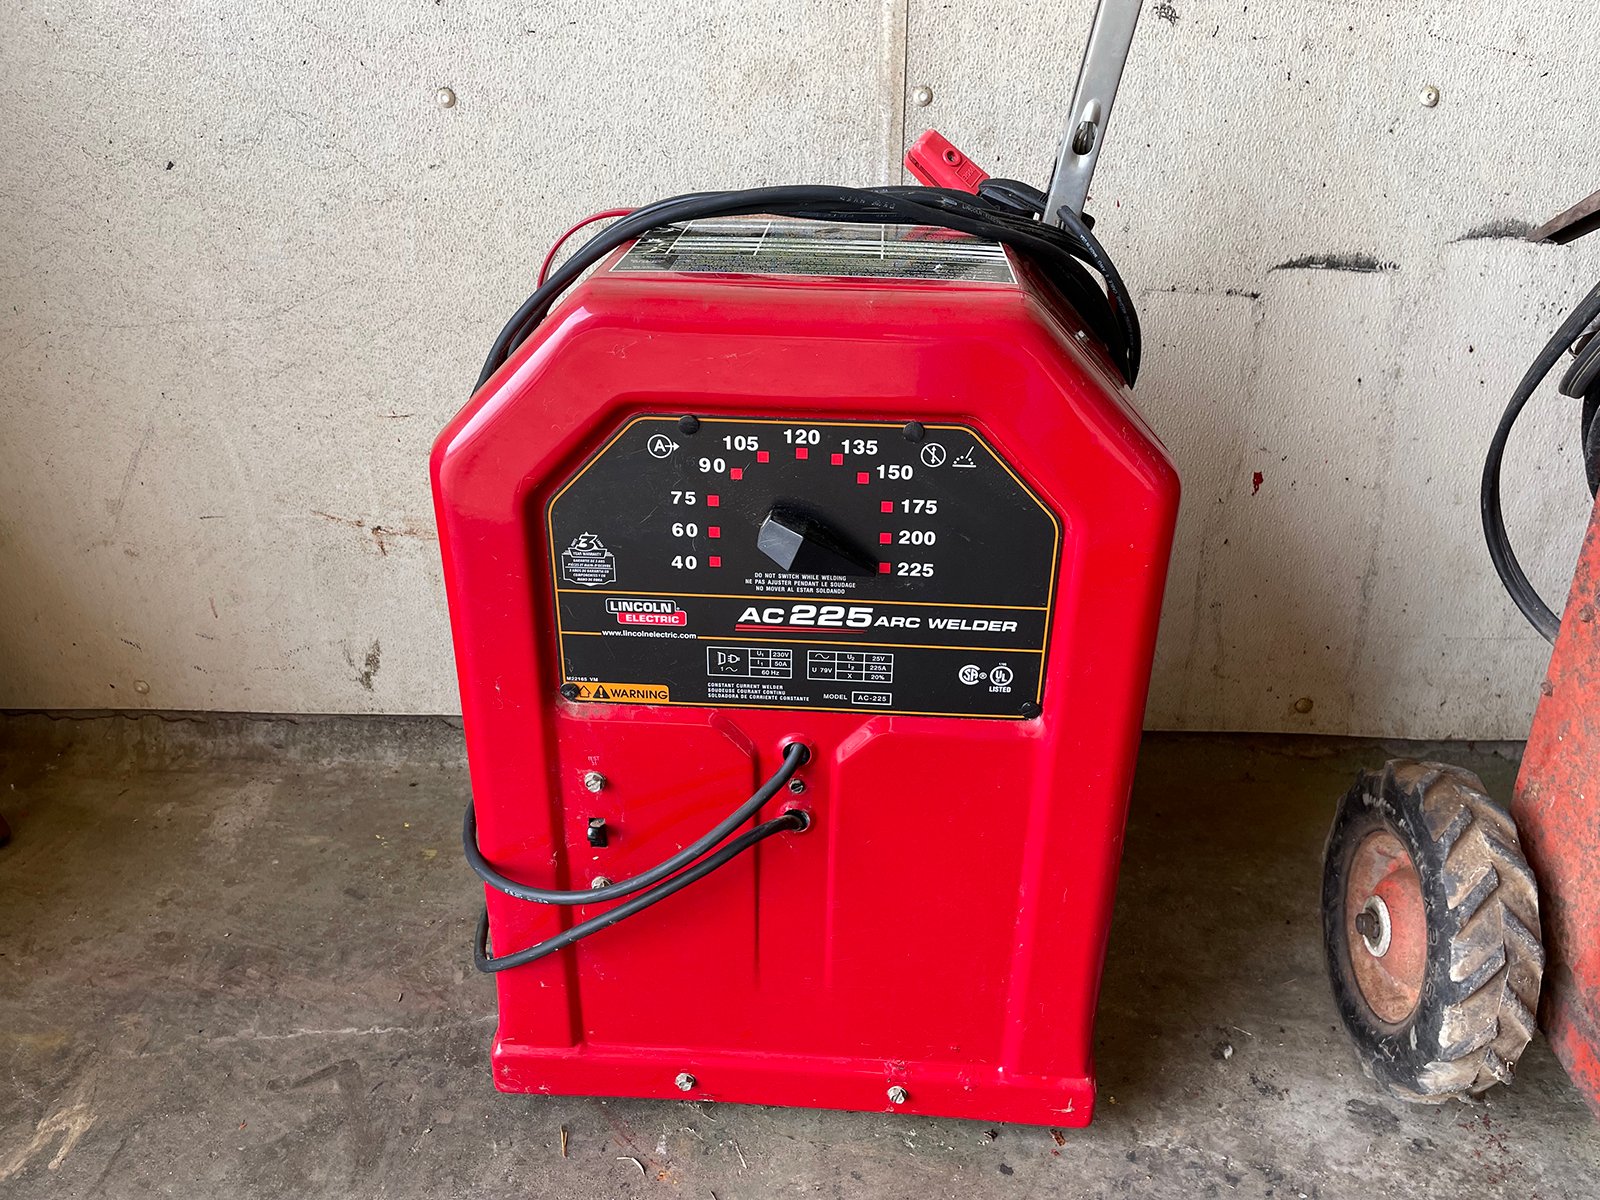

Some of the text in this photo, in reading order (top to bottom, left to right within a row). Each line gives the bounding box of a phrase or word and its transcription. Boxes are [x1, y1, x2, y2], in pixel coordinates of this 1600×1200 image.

[722, 436, 759, 451] 105
[783, 429, 821, 445] 120
[841, 439, 878, 455] 135
[698, 457, 726, 473] 90
[876, 464, 914, 481] 150
[670, 491, 697, 505] 75
[901, 499, 938, 515] 175
[671, 522, 698, 538] 60
[898, 530, 936, 546] 200
[576, 534, 598, 551] 3
[671, 556, 698, 570] 40
[897, 562, 934, 578] 225
[610, 601, 672, 613] LINCOLN
[626, 614, 680, 624] ELECTRIC
[738, 605, 1018, 633] AC 225 ARC WELDER
[602, 630, 697, 639] www.lincolnelectric.com
[958, 664, 980, 685] CSA
[610, 688, 668, 700] WARNING
